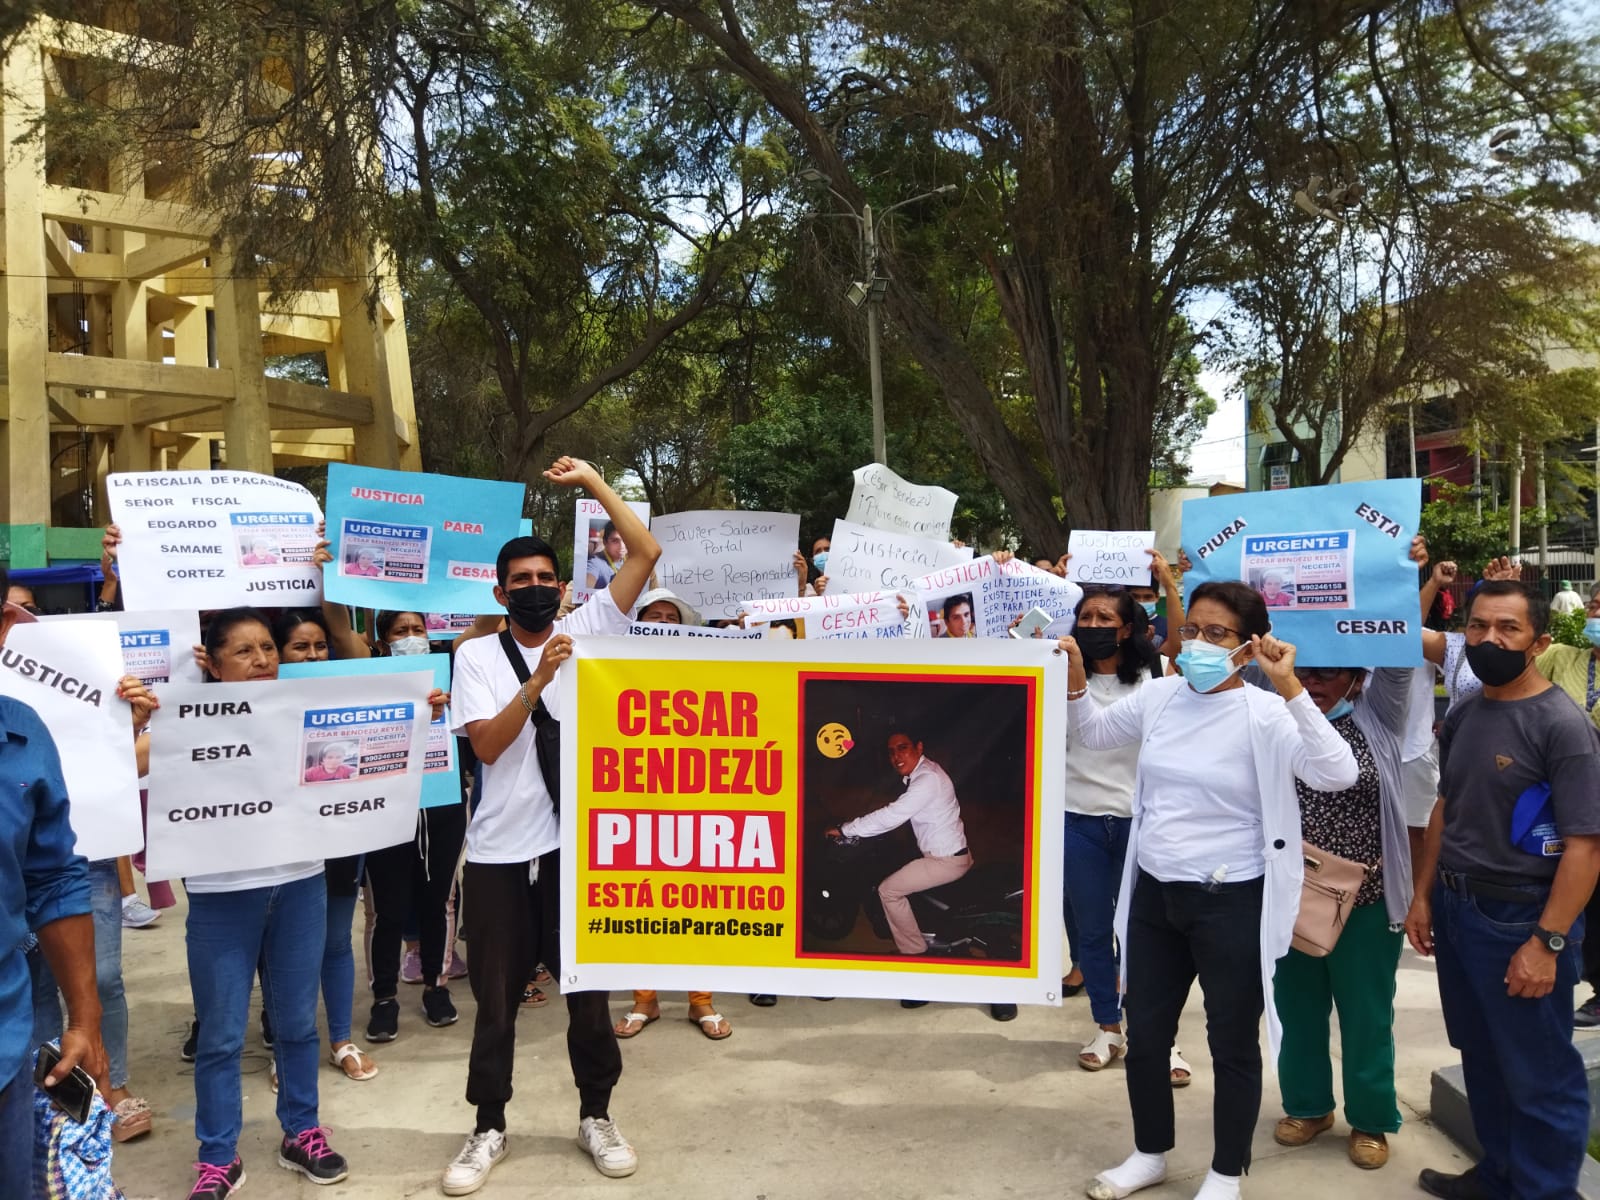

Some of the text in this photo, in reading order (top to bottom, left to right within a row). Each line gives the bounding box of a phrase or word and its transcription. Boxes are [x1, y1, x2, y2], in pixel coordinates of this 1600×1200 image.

[114, 475, 309, 496] LA FISCALIA DE PACASMAYO
[124, 497, 242, 507] SEÑOR FISCAL
[351, 487, 425, 505] JUSTICIA
[148, 519, 217, 529] EDGARDO
[236, 514, 308, 524] URGENTE
[443, 520, 483, 535] PARA
[1355, 502, 1403, 539] ESTA
[349, 524, 422, 538] URGENTE
[665, 519, 776, 543] Javier Salazar
[1196, 517, 1247, 560] PIURA
[160, 544, 223, 554] SAMAME
[701, 539, 743, 555] Portal
[1251, 536, 1341, 552] URGENTE
[167, 569, 226, 579] CORTEZ
[662, 562, 795, 588] Hazte Responsable
[921, 560, 992, 590] JUSTICIA
[1077, 563, 1141, 582] César
[245, 579, 317, 592] JUSTICIA
[1006, 576, 1051, 588] JUSTICIA
[1003, 600, 1024, 613] PARA
[822, 607, 880, 631] CESAR
[1336, 620, 1407, 635] CESAR
[876, 624, 904, 639] PARA
[179, 701, 252, 719] PIURA
[311, 707, 406, 725] URGENTE
[616, 688, 759, 738] CESAR
[191, 744, 252, 762] ESTA
[592, 741, 783, 796] BENDEZÚ
[168, 800, 274, 823] CONTIGO
[318, 797, 386, 817] CESAR
[596, 813, 777, 868] PIURA
[587, 878, 786, 911] ESTÁ CONTIGO
[587, 916, 785, 938] #JusticiaParaCesar
